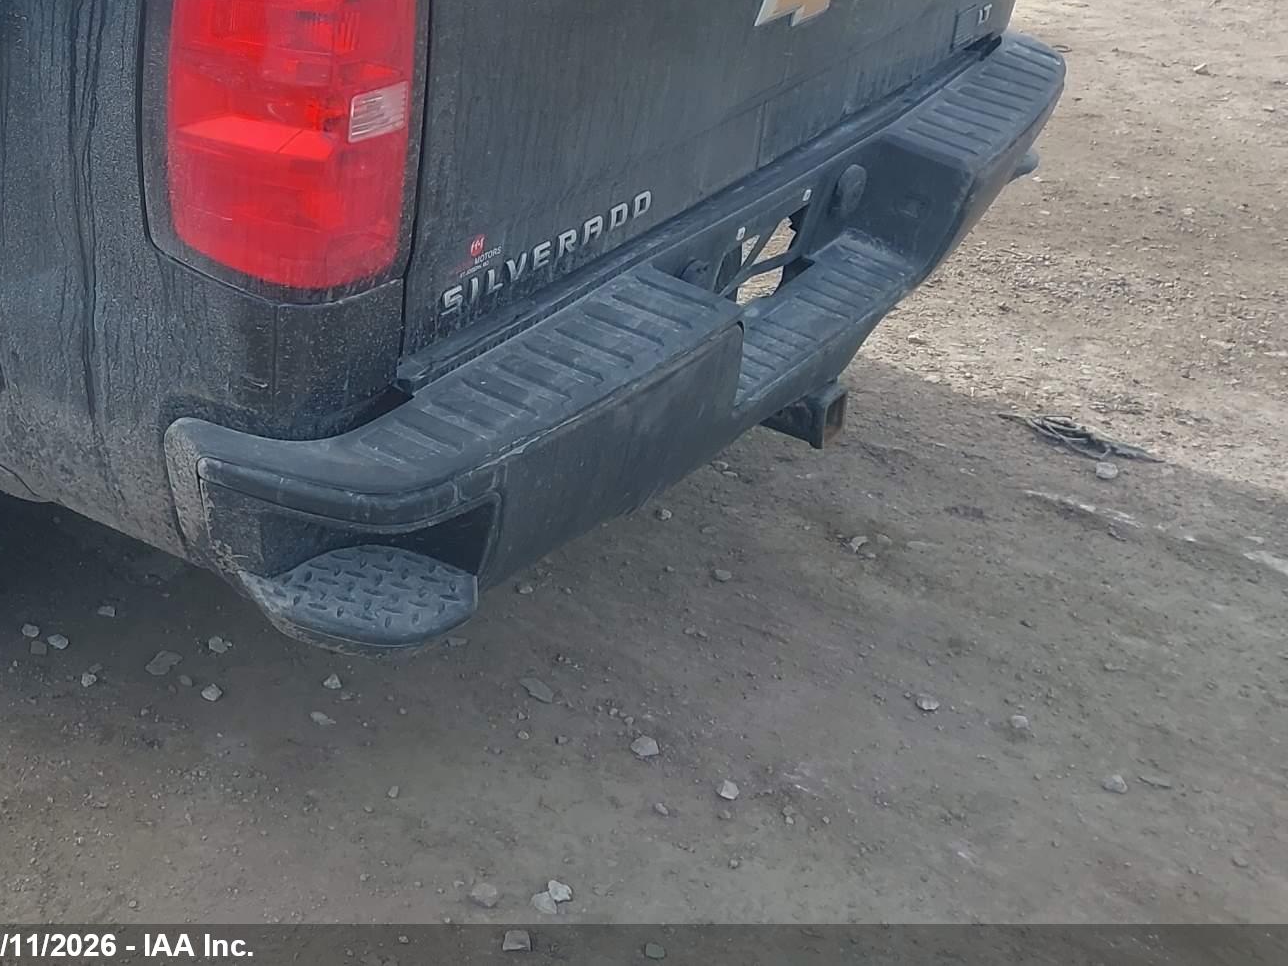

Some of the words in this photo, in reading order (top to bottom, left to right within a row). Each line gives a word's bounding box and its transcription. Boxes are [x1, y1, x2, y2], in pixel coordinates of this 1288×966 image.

[976, 3, 993, 26] LT
[440, 190, 652, 317] SILVERADO
[474, 245, 503, 265] MOTORS
